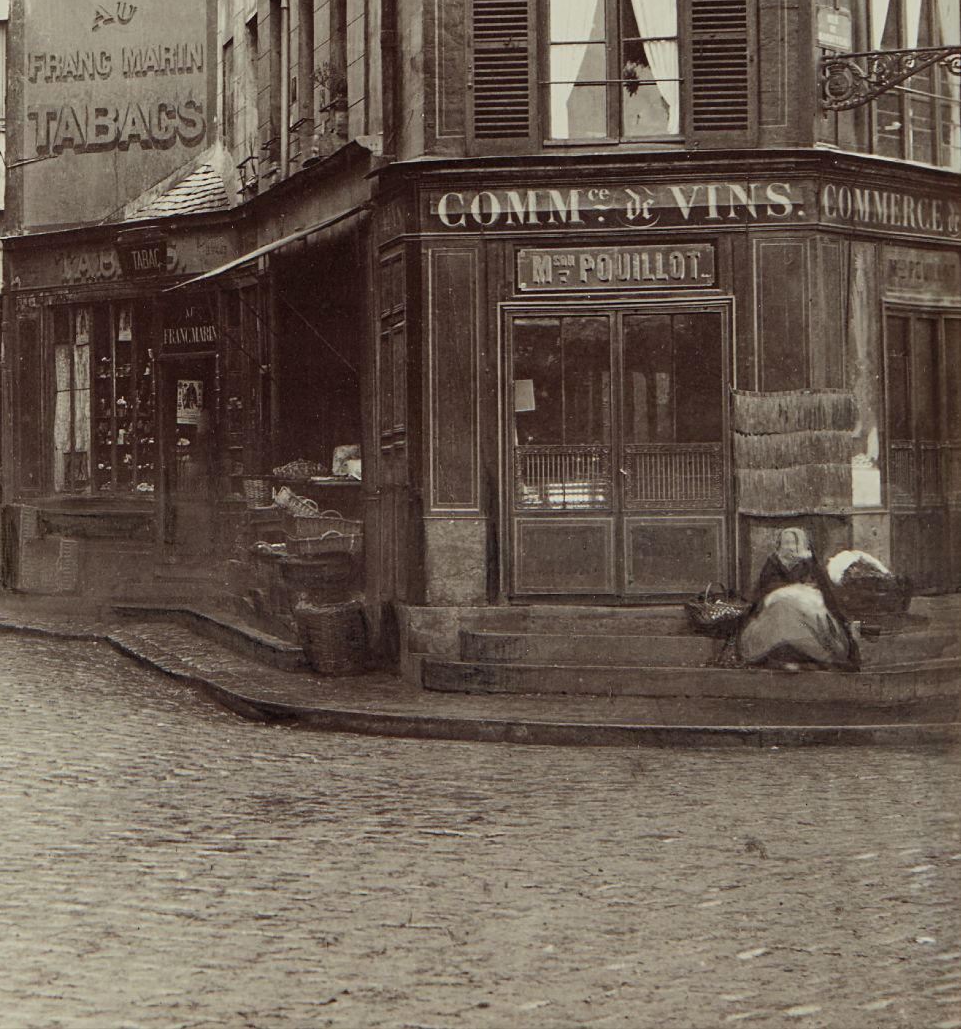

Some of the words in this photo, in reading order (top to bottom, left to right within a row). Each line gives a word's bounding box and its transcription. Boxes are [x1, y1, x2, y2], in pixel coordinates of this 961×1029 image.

[92, 1, 138, 32] AU
[28, 47, 112, 84] FRANC
[122, 43, 204, 77] MARIN
[27, 99, 206, 155] TABACS
[624, 186, 654, 220] de
[670, 182, 806, 220] VINS.
[824, 183, 943, 232] COMMERCE
